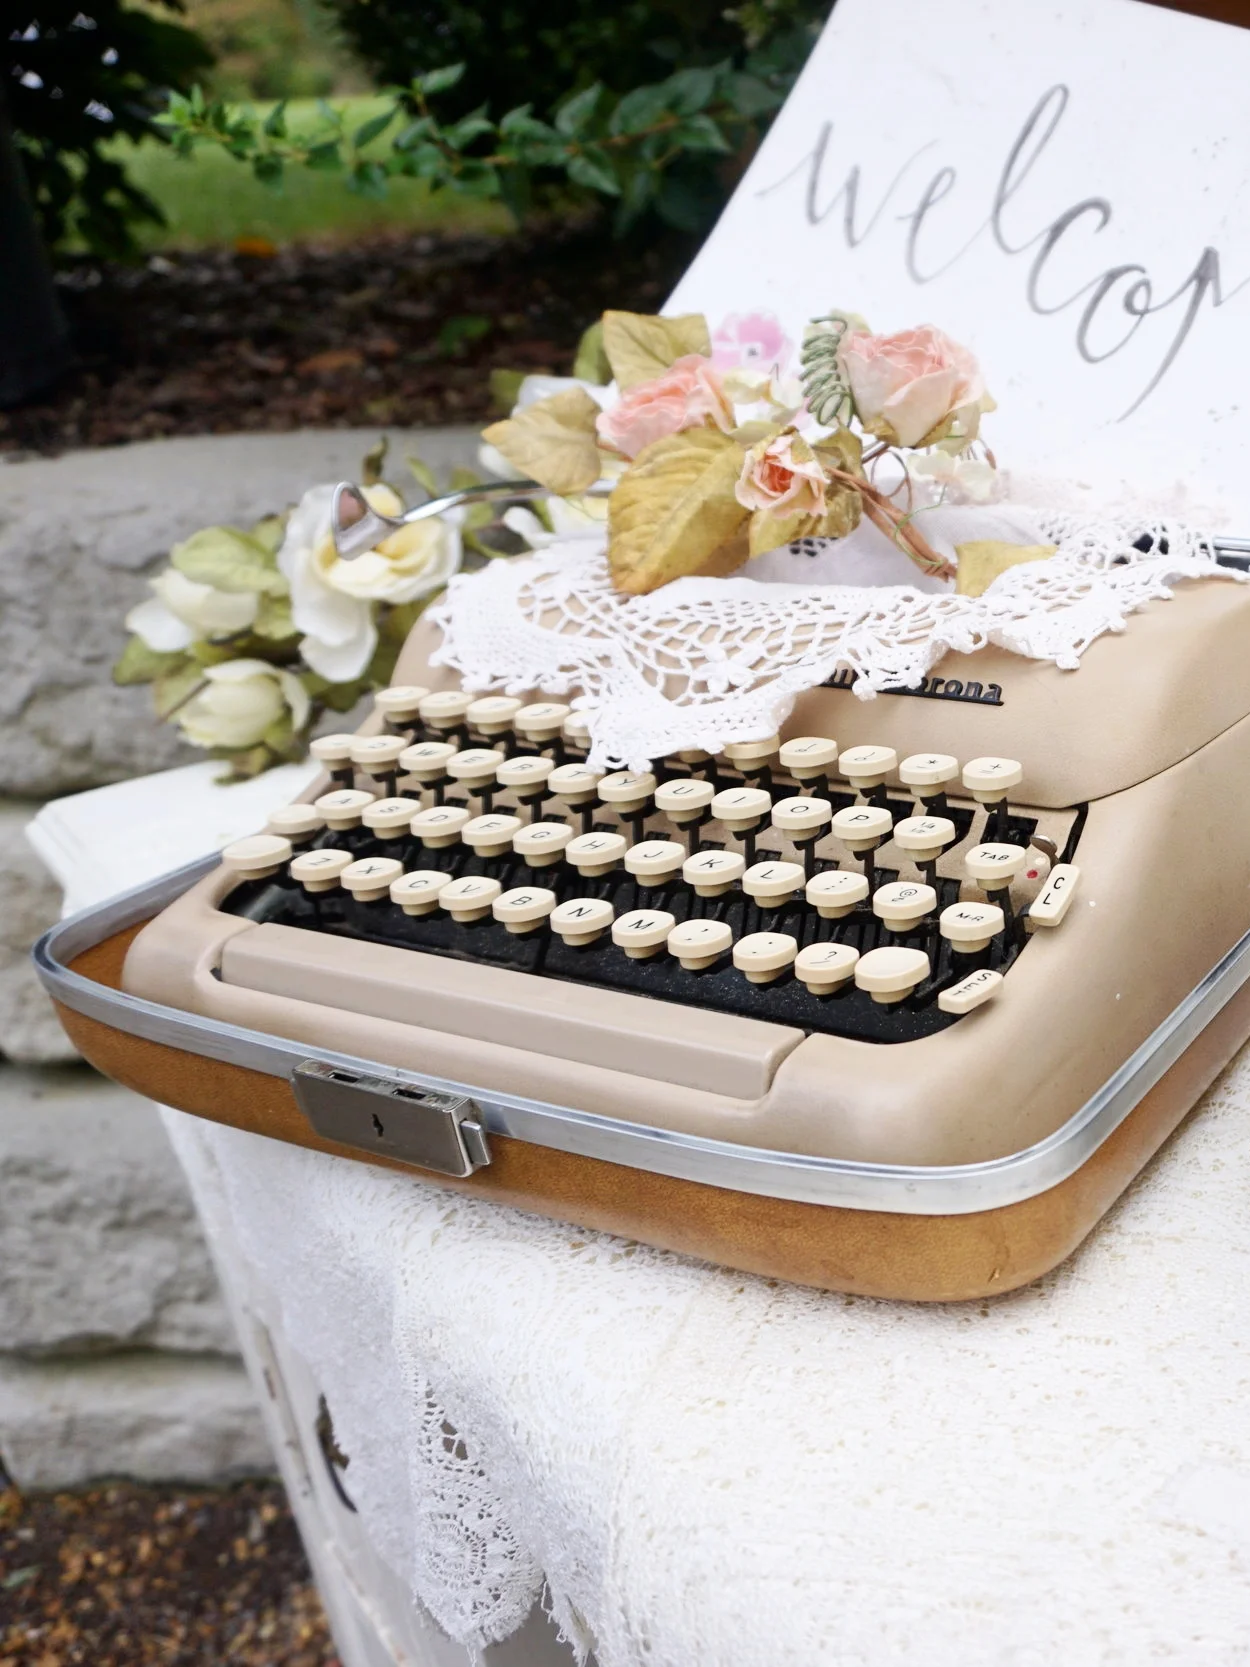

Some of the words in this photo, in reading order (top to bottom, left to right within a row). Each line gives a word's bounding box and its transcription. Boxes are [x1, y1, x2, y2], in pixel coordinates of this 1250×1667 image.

[463, 756, 486, 764] E
[513, 763, 534, 772] R
[568, 770, 587, 778] T
[618, 777, 636, 786] Y
[672, 786, 694, 795] U
[790, 805, 809, 814] O
[849, 814, 869, 822] P
[428, 814, 448, 823] D
[481, 821, 502, 830] F
[531, 831, 551, 839] G
[582, 840, 605, 850] H
[644, 850, 664, 859] J
[699, 858, 723, 868] K
[760, 868, 774, 880] L
[979, 851, 1010, 862] TAB
[359, 865, 382, 875] X
[409, 879, 428, 889] C
[461, 884, 481, 894] V
[509, 895, 532, 905] B
[568, 907, 592, 918] N
[628, 919, 655, 931] M
[825, 951, 838, 960] ?
[953, 972, 993, 996] SET
